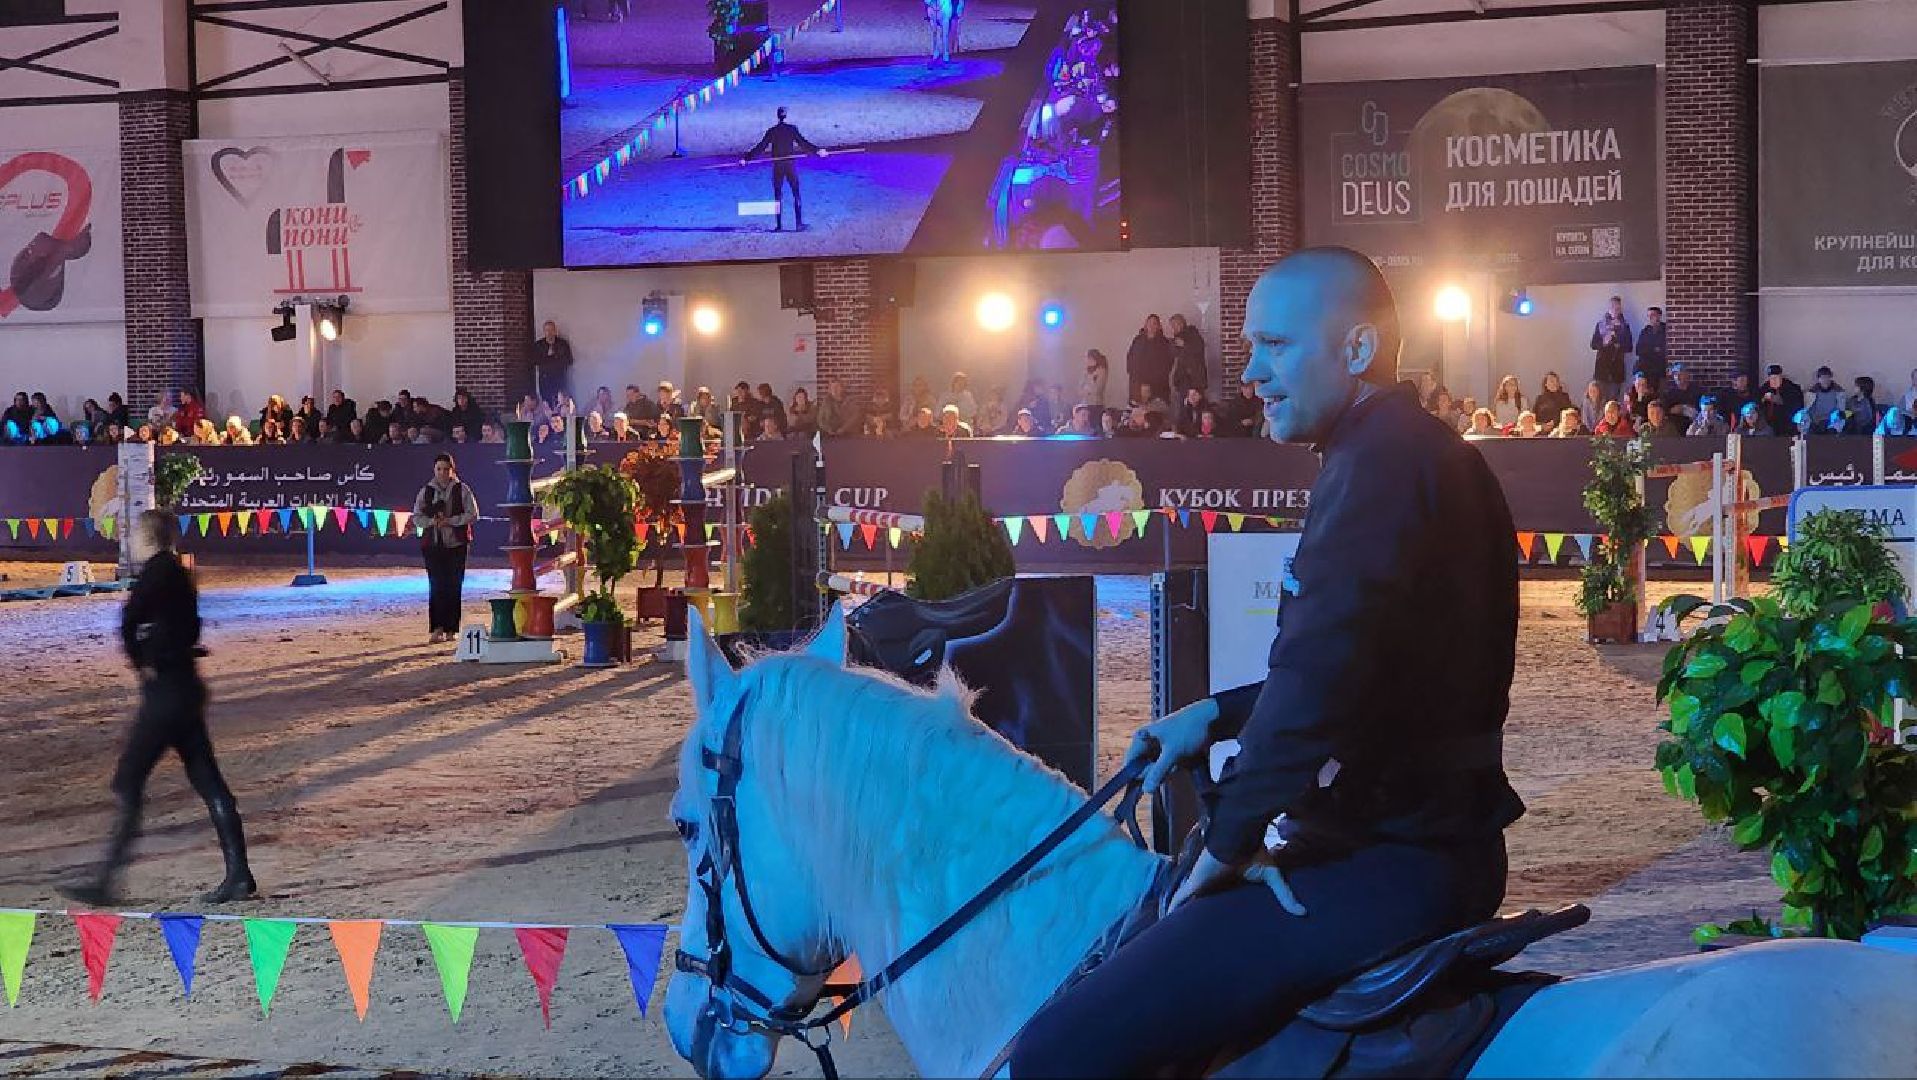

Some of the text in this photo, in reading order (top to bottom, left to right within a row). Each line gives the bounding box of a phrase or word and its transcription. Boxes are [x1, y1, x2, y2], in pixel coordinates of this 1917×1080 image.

[1446, 127, 1621, 168] КОСМЕТИКА
[1341, 152, 1411, 178] COSMO
[1342, 181, 1411, 216] DEUS
[1445, 169, 1622, 212] ДЛЯ ЛОШАДЕЙ
[0, 193, 62, 210] PLUS
[284, 207, 348, 225] КОНИ
[283, 228, 348, 247] ПОНИ
[1814, 231, 1915, 250] КРУПНЕЙШ
[1857, 255, 1895, 272] ДЛЯ
[274, 466, 332, 486] صاحب
[834, 487, 888, 507] CUP
[1158, 488, 1310, 508] КУБОК ПРЕЗ
[1655, 611, 1666, 633] 4
[466, 629, 480, 654] 11
